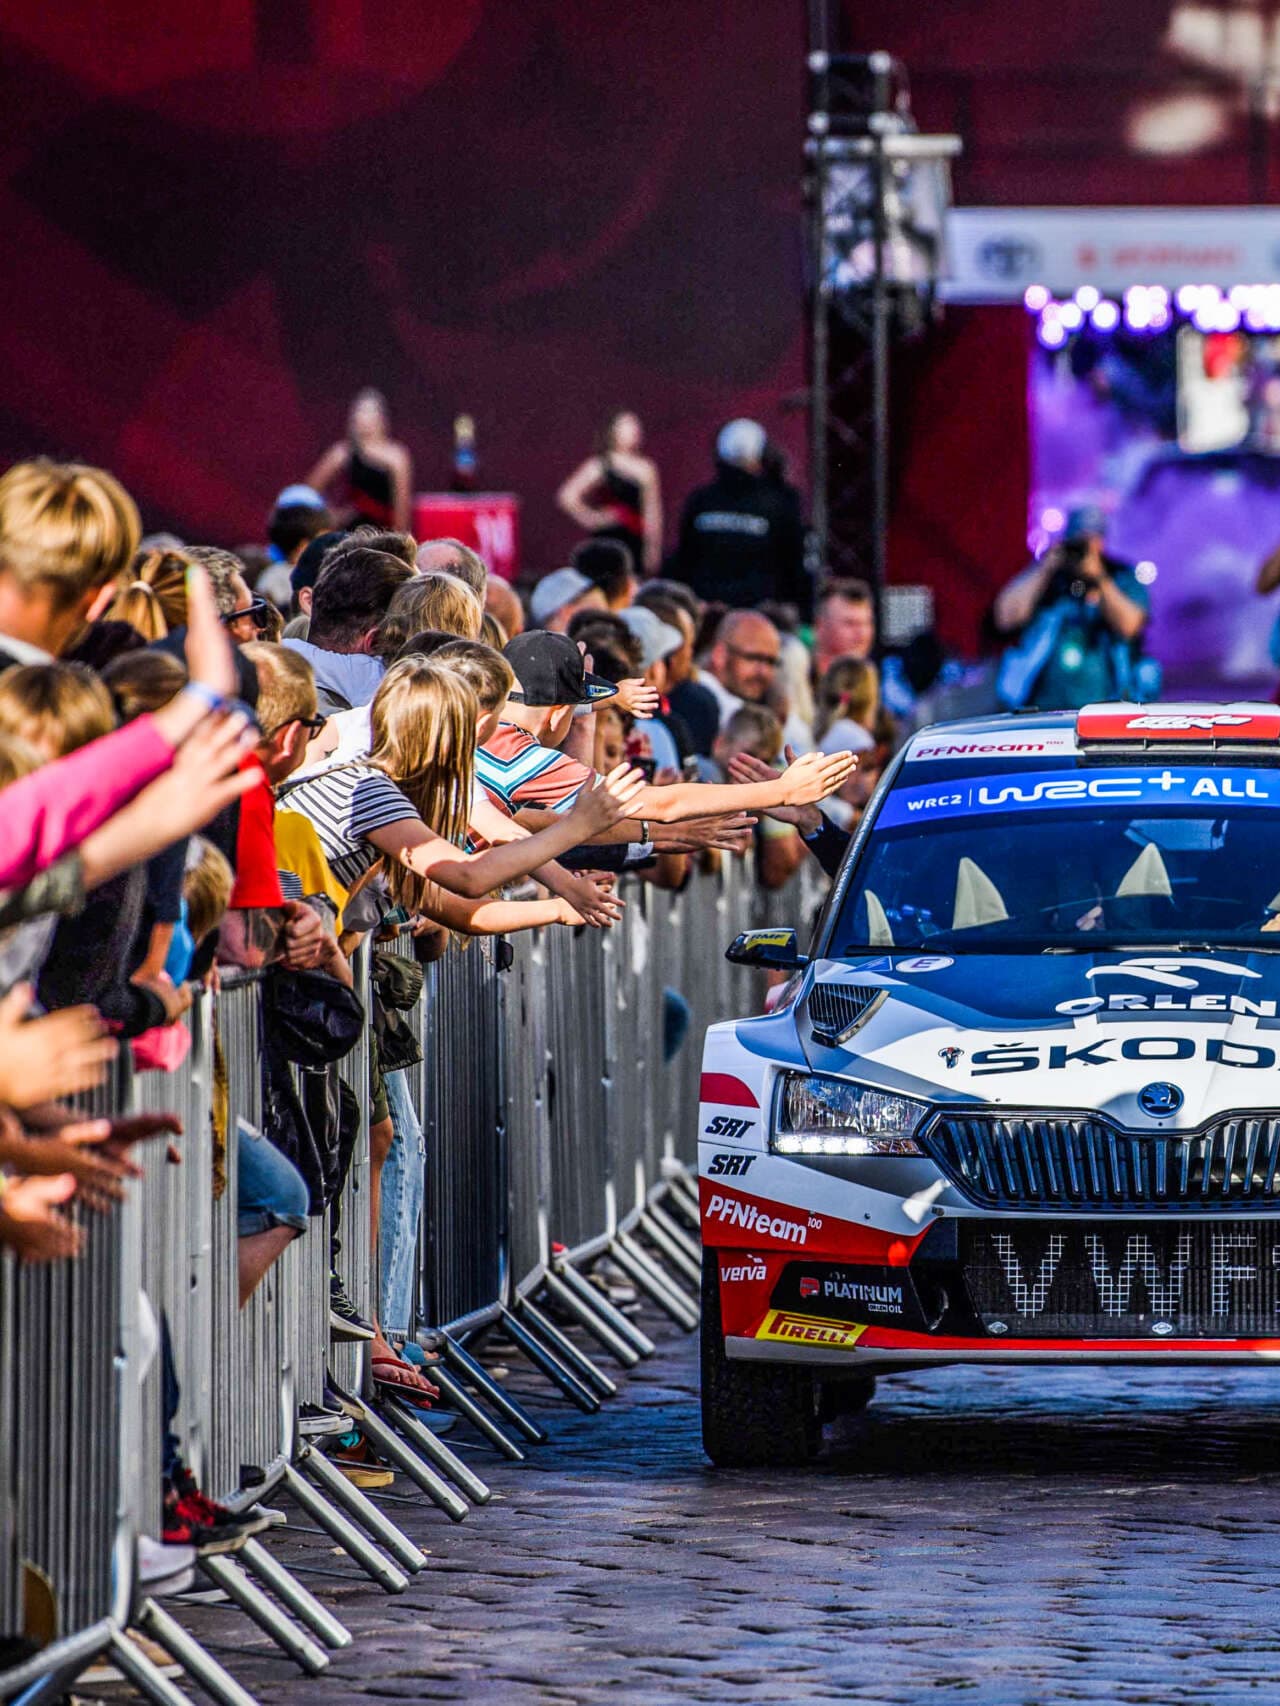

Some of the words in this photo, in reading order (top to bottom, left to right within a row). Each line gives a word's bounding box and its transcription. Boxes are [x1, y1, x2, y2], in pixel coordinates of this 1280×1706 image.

[915, 743, 1045, 758] PFNteam
[1191, 777, 1269, 799] ALL
[907, 794, 963, 812] WRC2
[1055, 994, 1277, 1017] ORLEN
[704, 1115, 757, 1138] SRT
[707, 1154, 757, 1176] SRT
[705, 1195, 808, 1245] PFNteam
[807, 1216, 823, 1230] 100
[720, 1264, 768, 1282] verva
[823, 1280, 903, 1303] PLATINUM
[888, 1304, 904, 1314] OIL
[767, 1312, 857, 1344] PIRELLI
